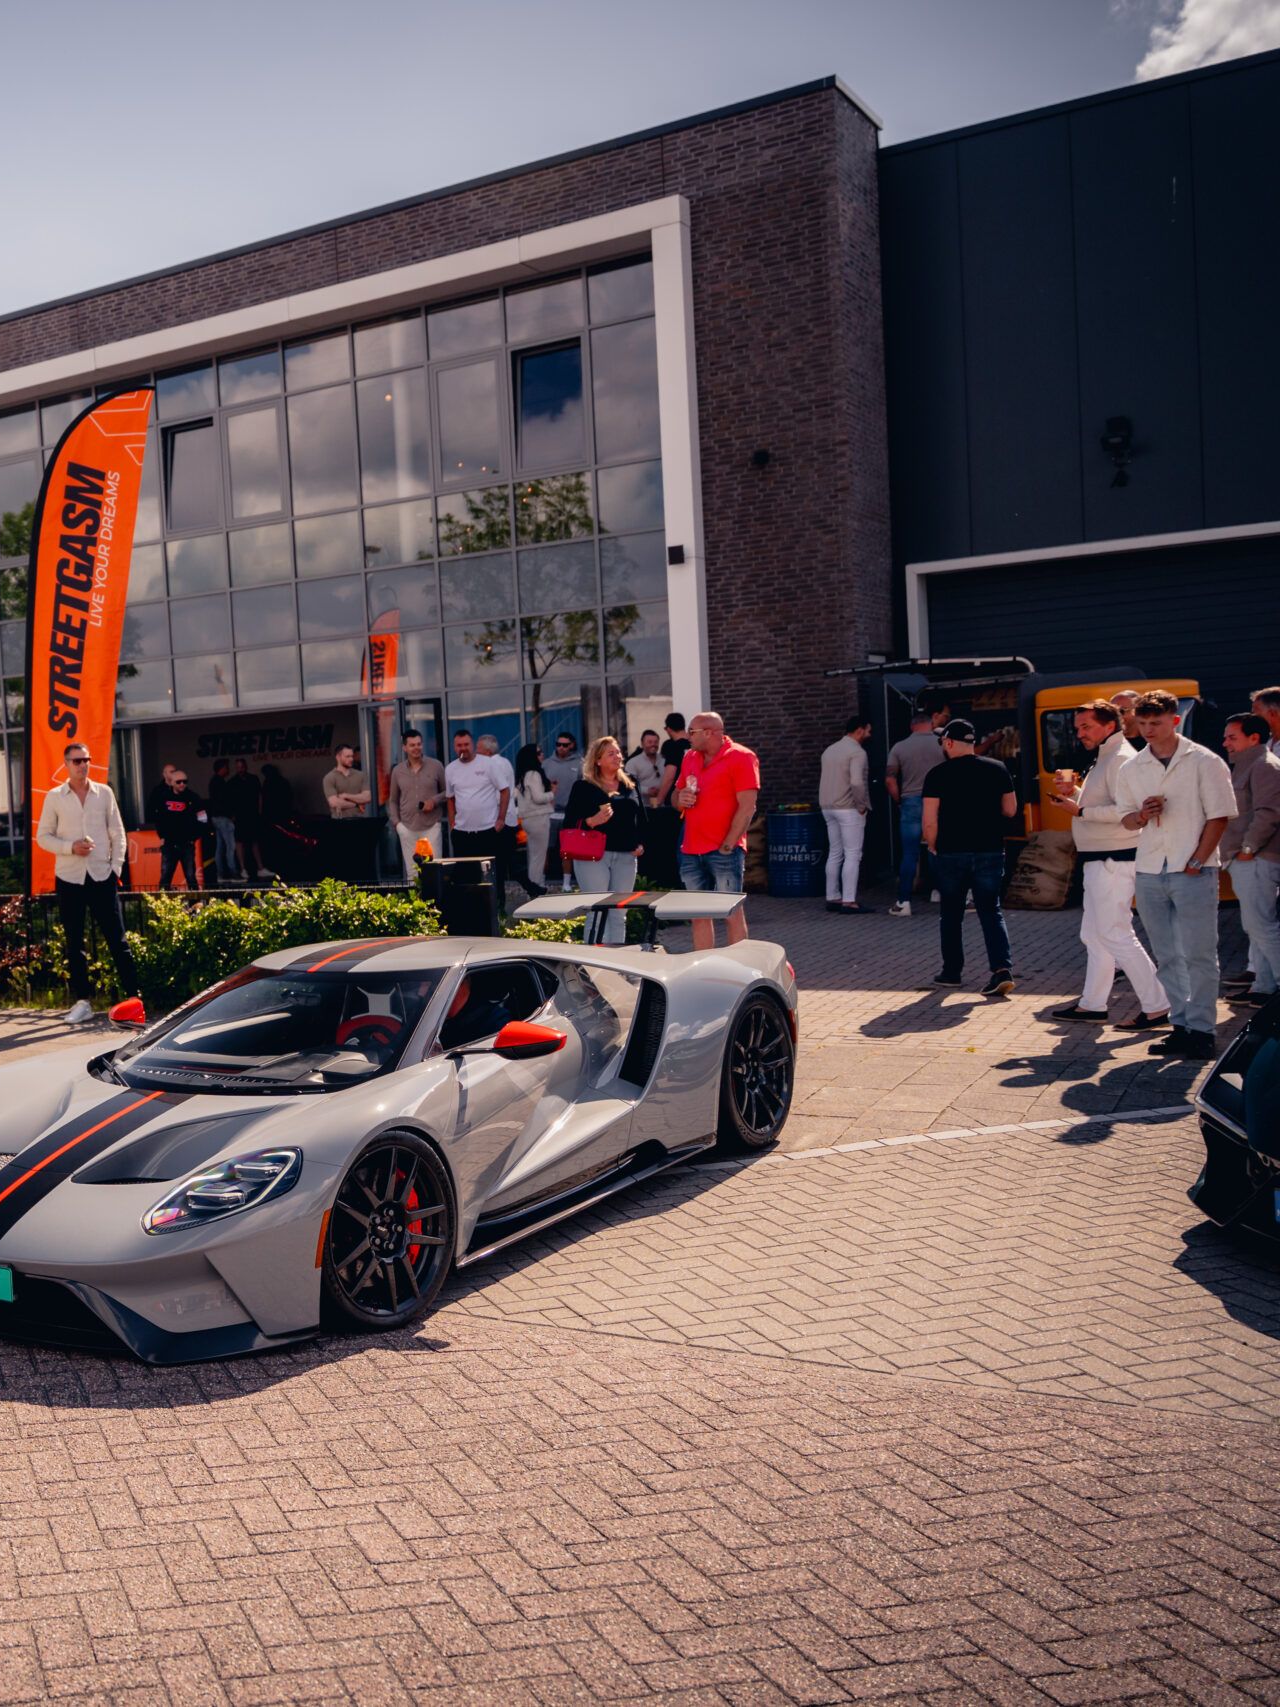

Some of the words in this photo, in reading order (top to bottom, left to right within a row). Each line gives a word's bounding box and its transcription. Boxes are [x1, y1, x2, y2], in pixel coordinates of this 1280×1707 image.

[100, 470, 121, 542] DREAMS
[94, 543, 111, 588] YOUR
[48, 461, 106, 739] STREETGASM
[89, 594, 106, 627] LIVE
[196, 724, 335, 758] STREETGASM
